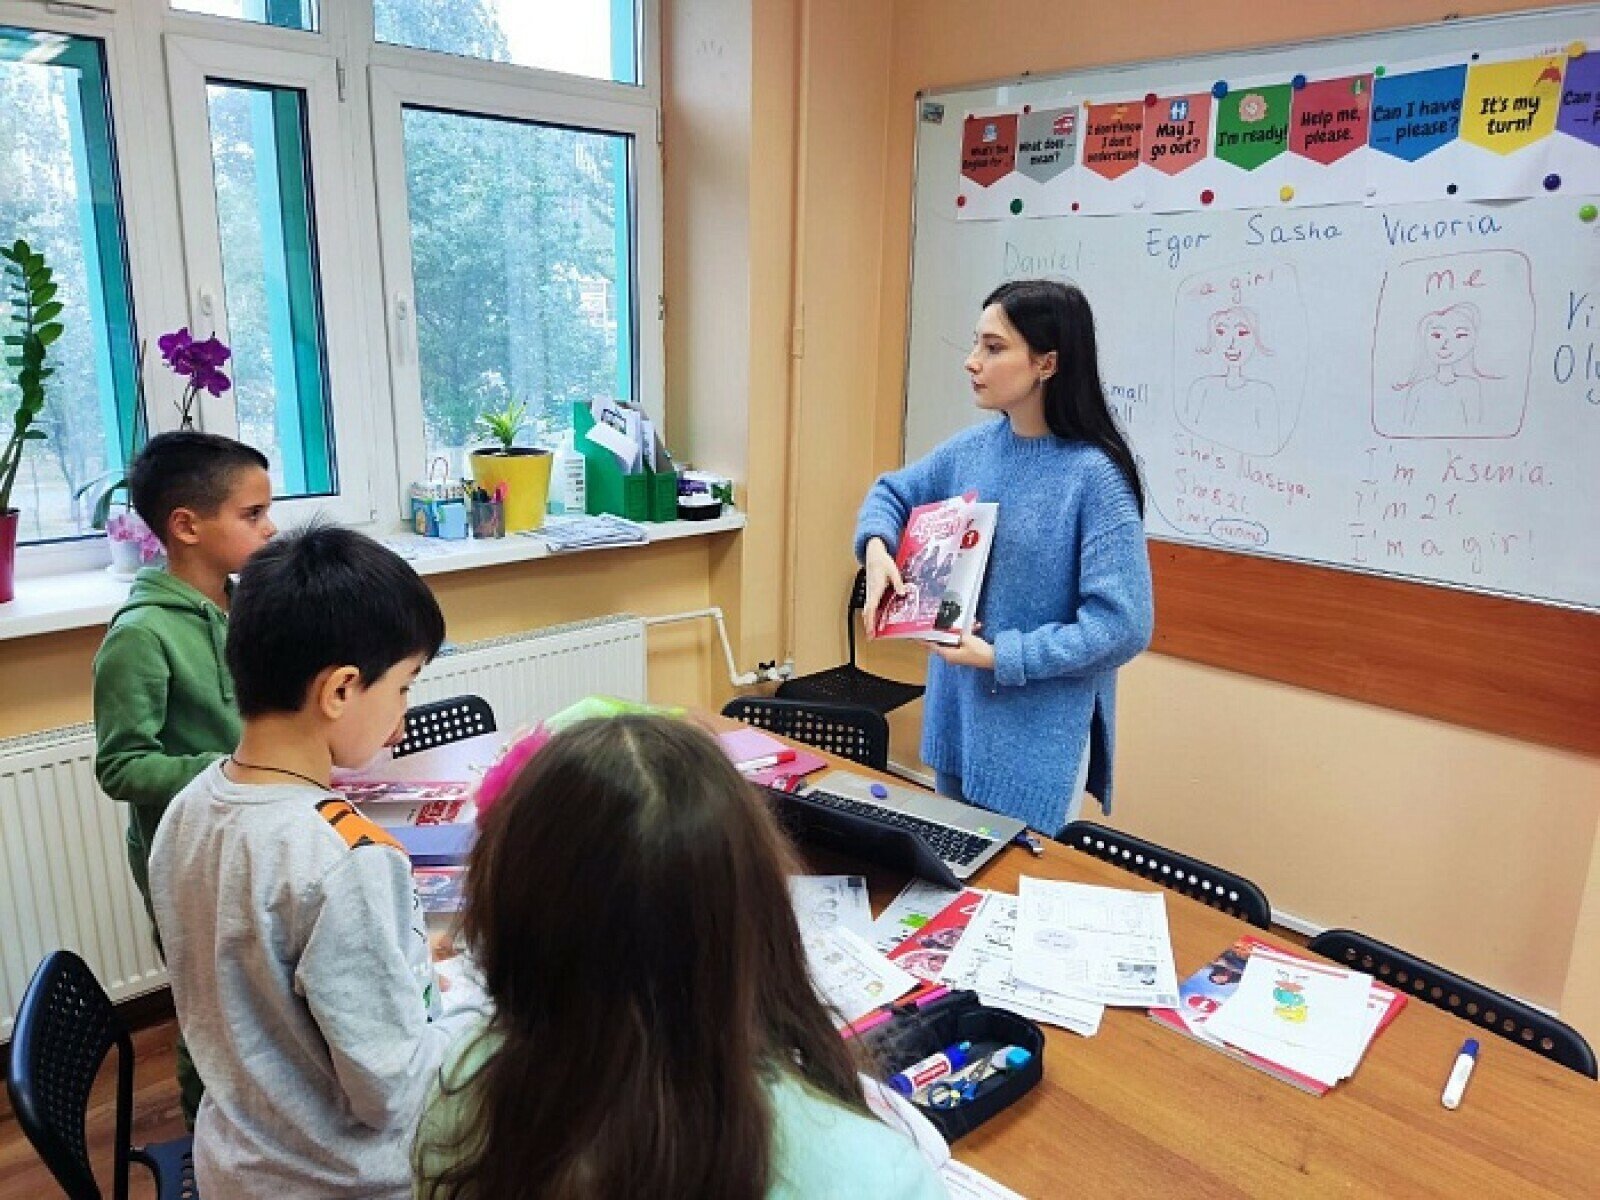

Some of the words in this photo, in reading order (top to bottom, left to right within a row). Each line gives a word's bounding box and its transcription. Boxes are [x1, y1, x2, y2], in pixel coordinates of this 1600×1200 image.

[1373, 105, 1402, 122] Can
[1406, 101, 1415, 119] I
[1420, 96, 1463, 116] have
[1480, 97, 1509, 116] It's
[1513, 94, 1541, 117] my
[1563, 90, 1592, 106] Can
[1156, 122, 1185, 139] May
[1186, 120, 1195, 136] I
[1301, 111, 1335, 129] Help
[1337, 107, 1361, 124] me,
[1487, 111, 1537, 135] turn!
[1217, 126, 1239, 147] I'm
[1241, 123, 1288, 146] ready!
[1396, 117, 1460, 145] please?
[1151, 143, 1168, 161] go
[1169, 138, 1201, 155] out?
[1145, 227, 1212, 269] Egor
[1246, 212, 1342, 247] Sasha
[1382, 211, 1503, 246] Victoria
[1425, 268, 1488, 296] me
[1106, 383, 1149, 404] mall
[1420, 538, 1445, 556] a
